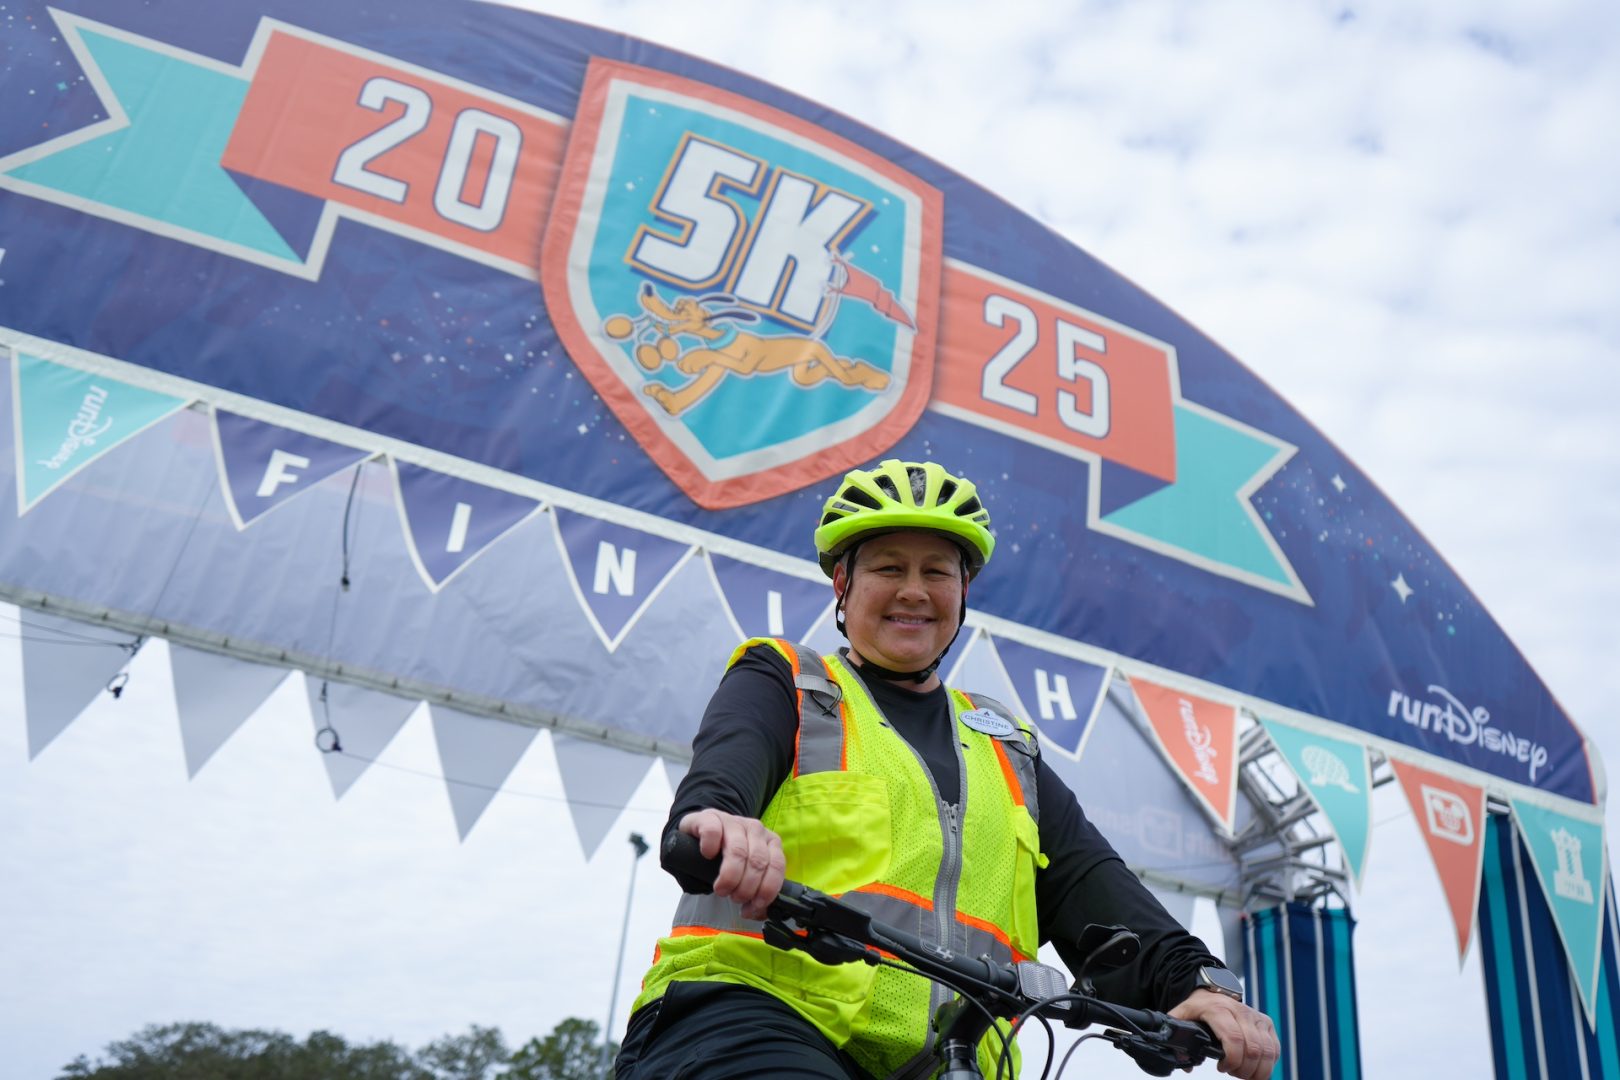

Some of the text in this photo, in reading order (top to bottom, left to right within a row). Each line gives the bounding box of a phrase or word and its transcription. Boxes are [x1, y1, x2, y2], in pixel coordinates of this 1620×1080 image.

[331, 75, 524, 233] 20
[625, 132, 876, 335] 5K
[982, 294, 1111, 440] 25
[964, 714, 1010, 731] CHRISTINE
